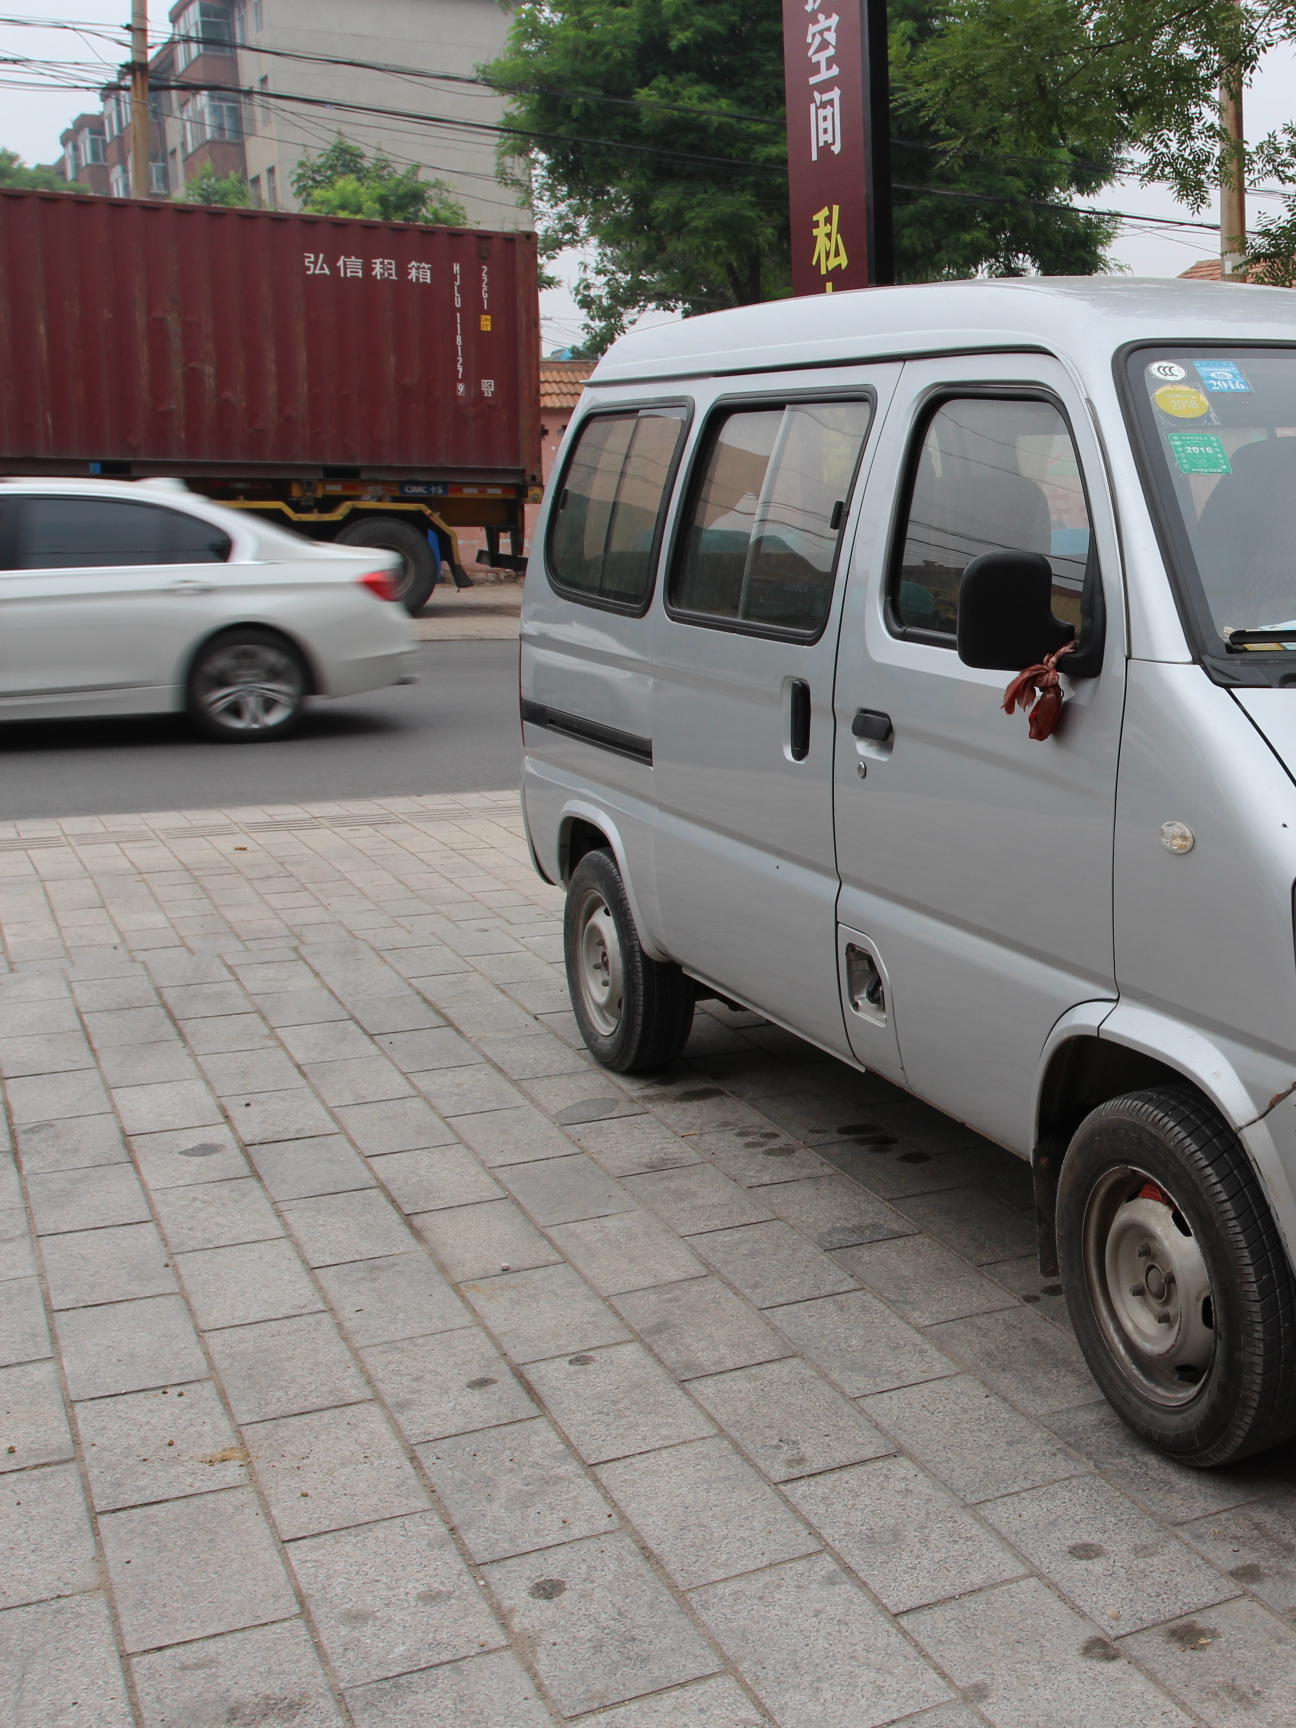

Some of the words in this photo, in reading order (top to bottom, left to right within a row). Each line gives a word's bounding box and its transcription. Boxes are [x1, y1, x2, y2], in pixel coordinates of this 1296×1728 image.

[804, 0, 841, 161] 空间
[812, 204, 848, 293] 私
[303, 253, 432, 284] 弘信租箱
[453, 263, 461, 308] HJLU
[1209, 380, 1245, 390] 2016
[1169, 399, 1199, 410] 2016
[404, 485, 428, 493] CIMC
